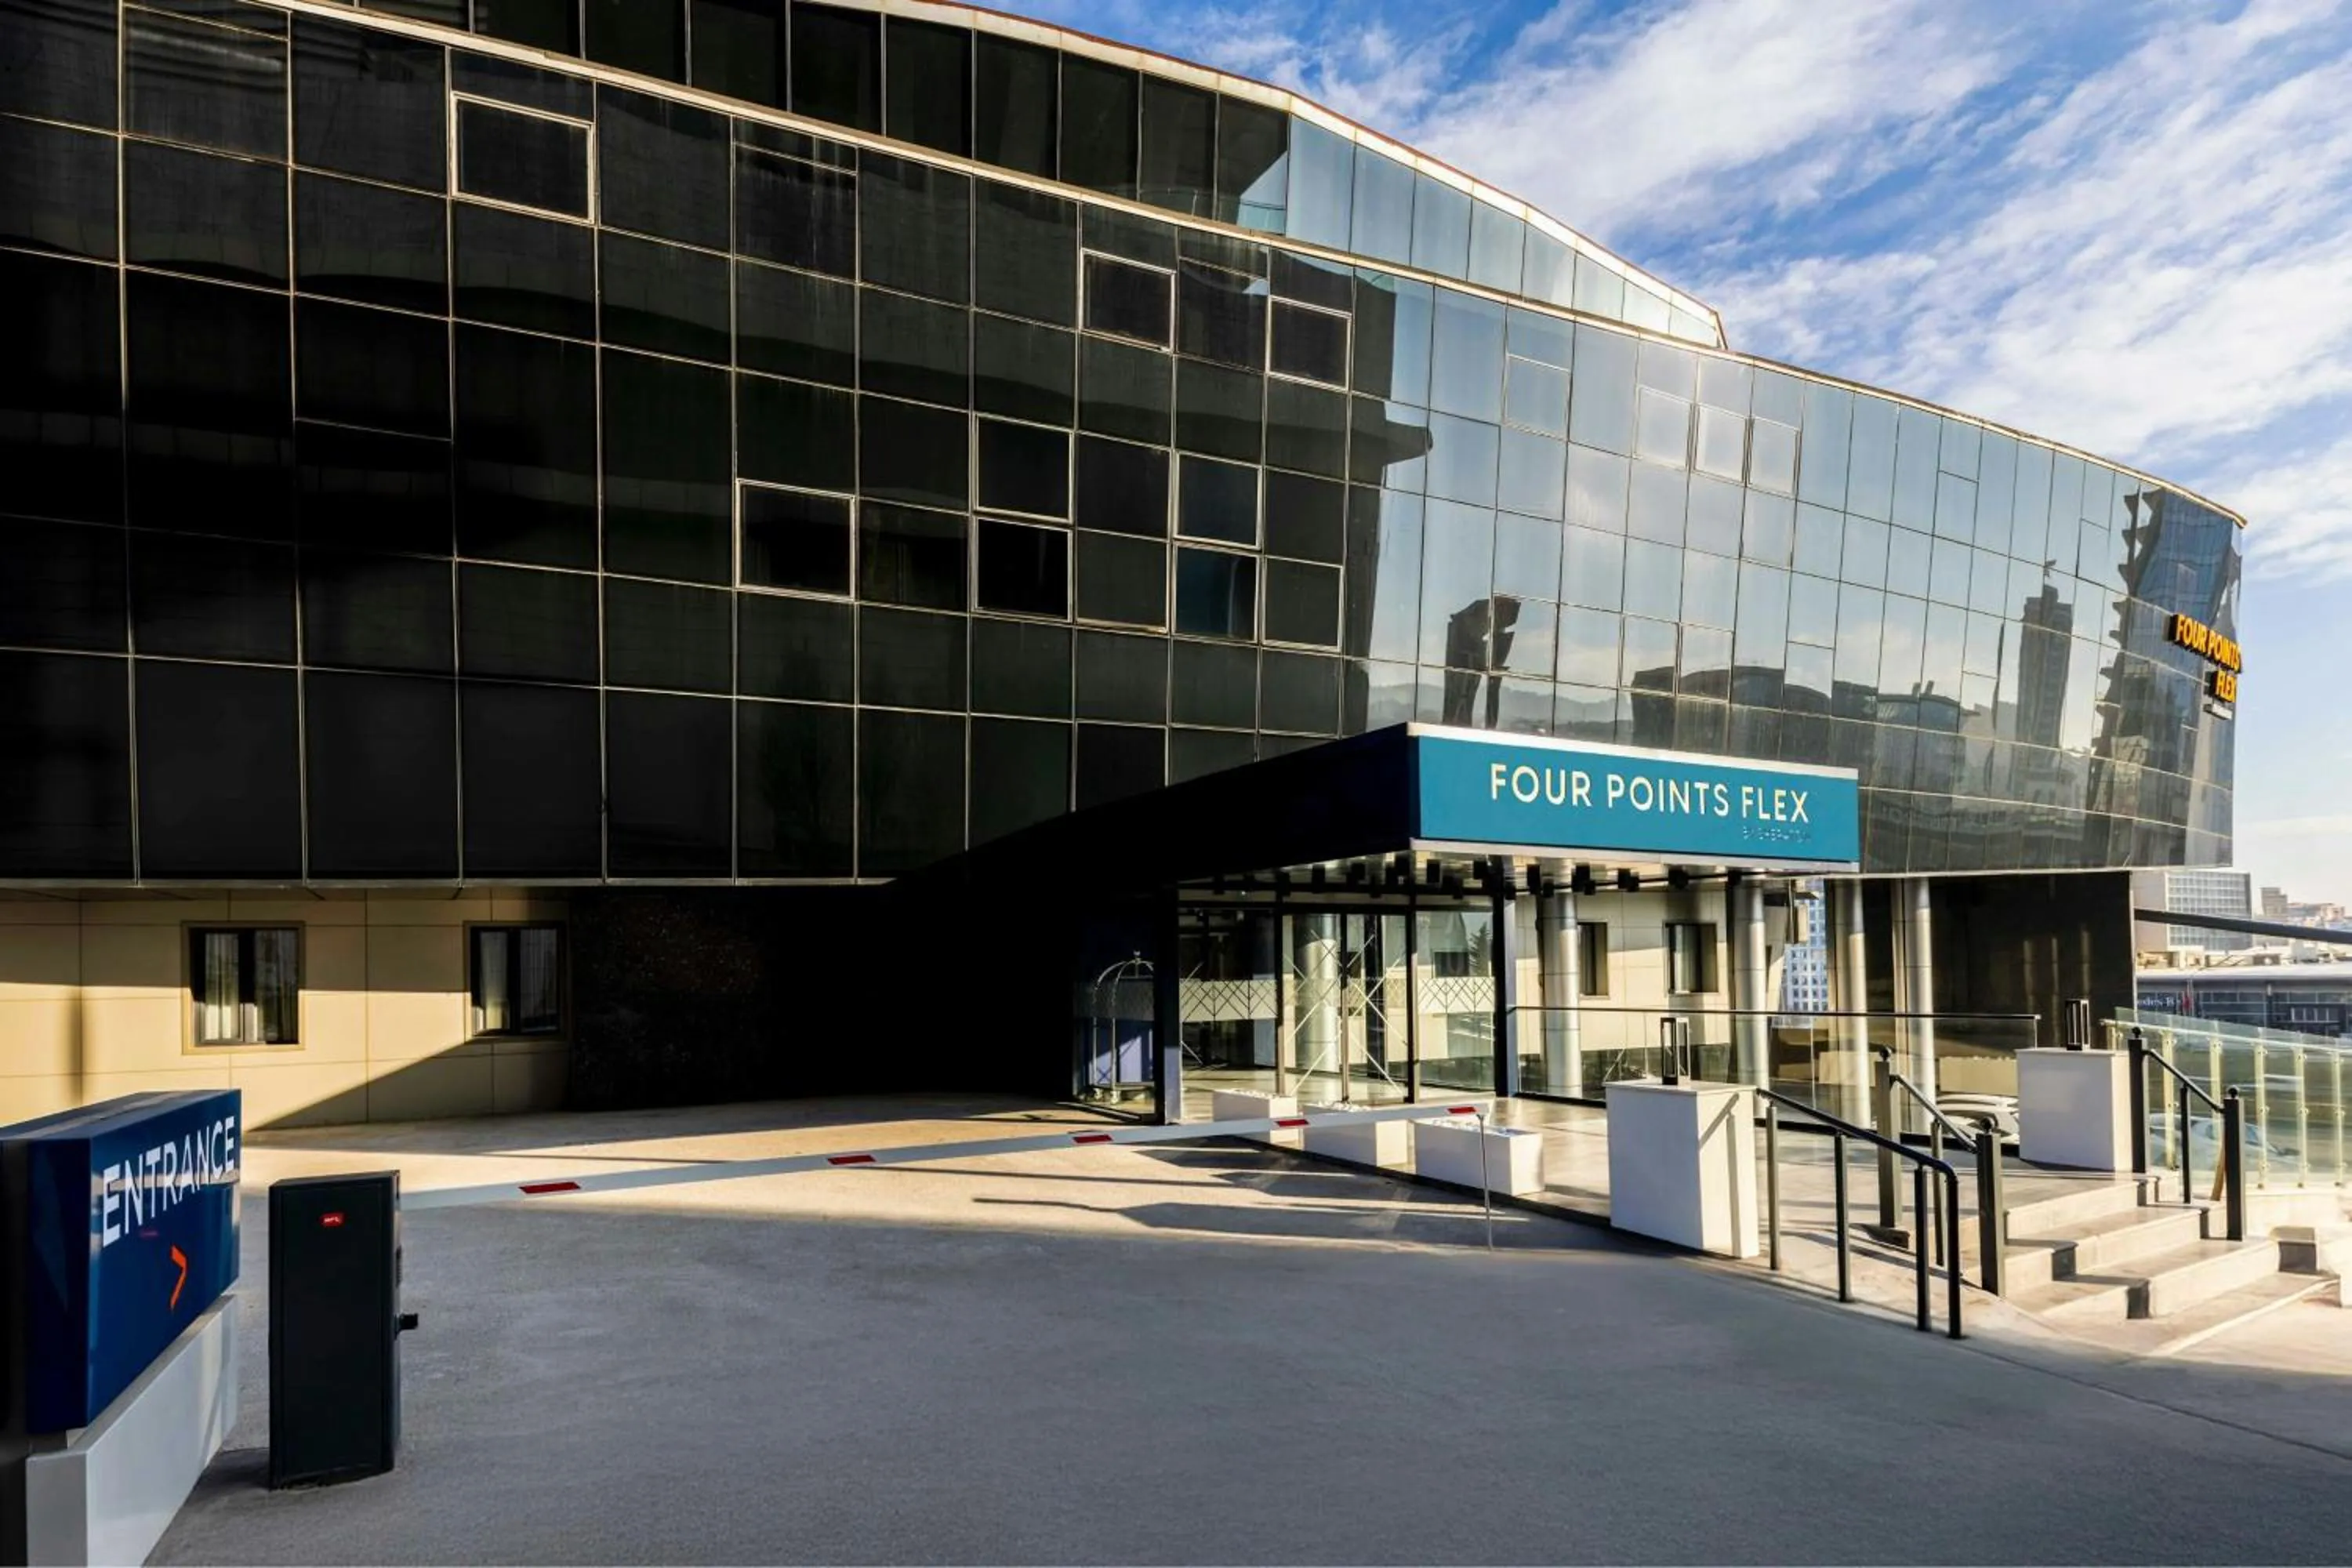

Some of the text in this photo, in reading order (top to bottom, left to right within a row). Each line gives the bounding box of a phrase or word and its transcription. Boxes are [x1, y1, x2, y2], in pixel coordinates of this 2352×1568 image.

[2176, 614, 2241, 671] FOUR POINTS
[1490, 763, 1809, 823] FOUR POINTS FLEX
[103, 1116, 234, 1247] ENTRANCE
